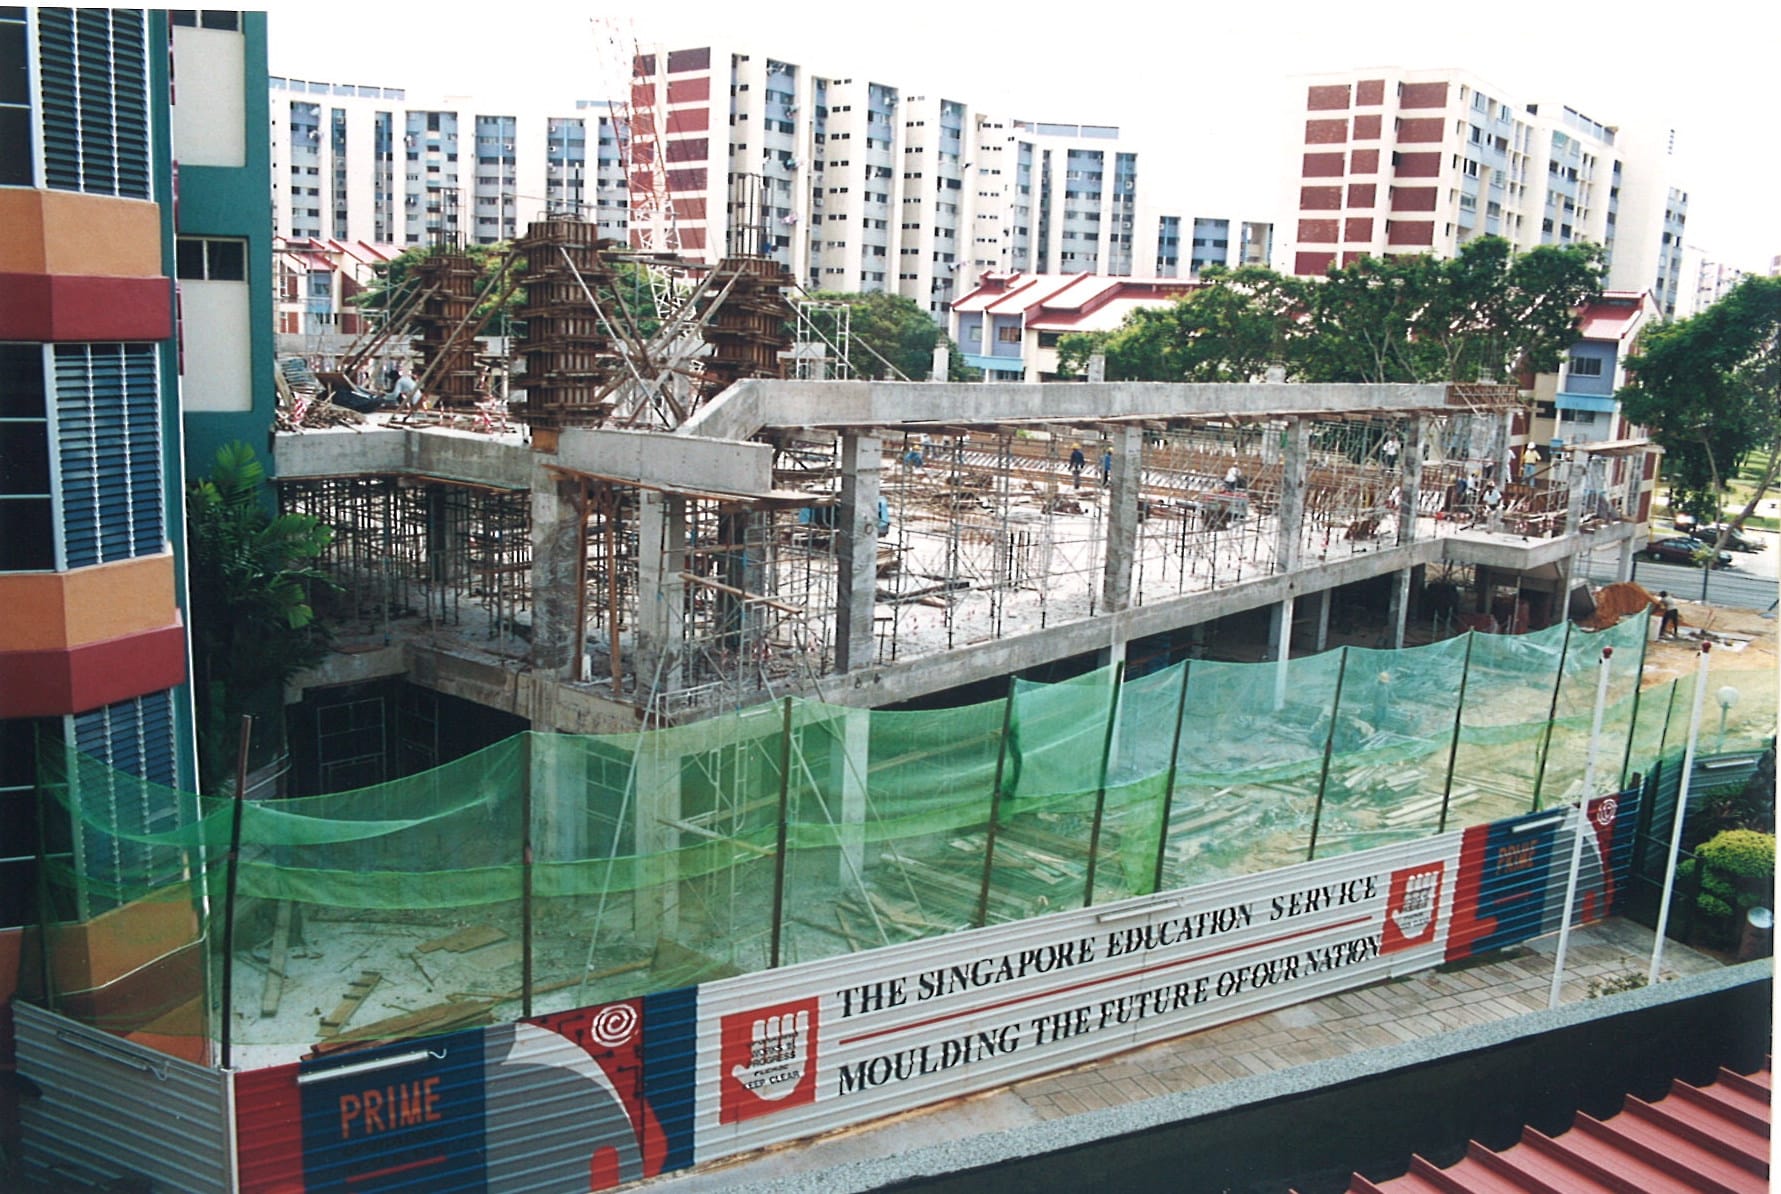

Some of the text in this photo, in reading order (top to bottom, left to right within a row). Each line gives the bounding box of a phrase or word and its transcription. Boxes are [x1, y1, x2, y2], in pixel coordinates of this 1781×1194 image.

[837, 875, 1378, 1018] THE SINGAPORE EDUCATION SERVICE
[839, 1024, 1020, 1096] MOULDING
[1032, 1006, 1091, 1045] THE
[1099, 977, 1209, 1029] FUTURE
[1304, 934, 1380, 976] NATION
[339, 1076, 442, 1139] PRIME
[769, 1070, 800, 1084] CLEAR
